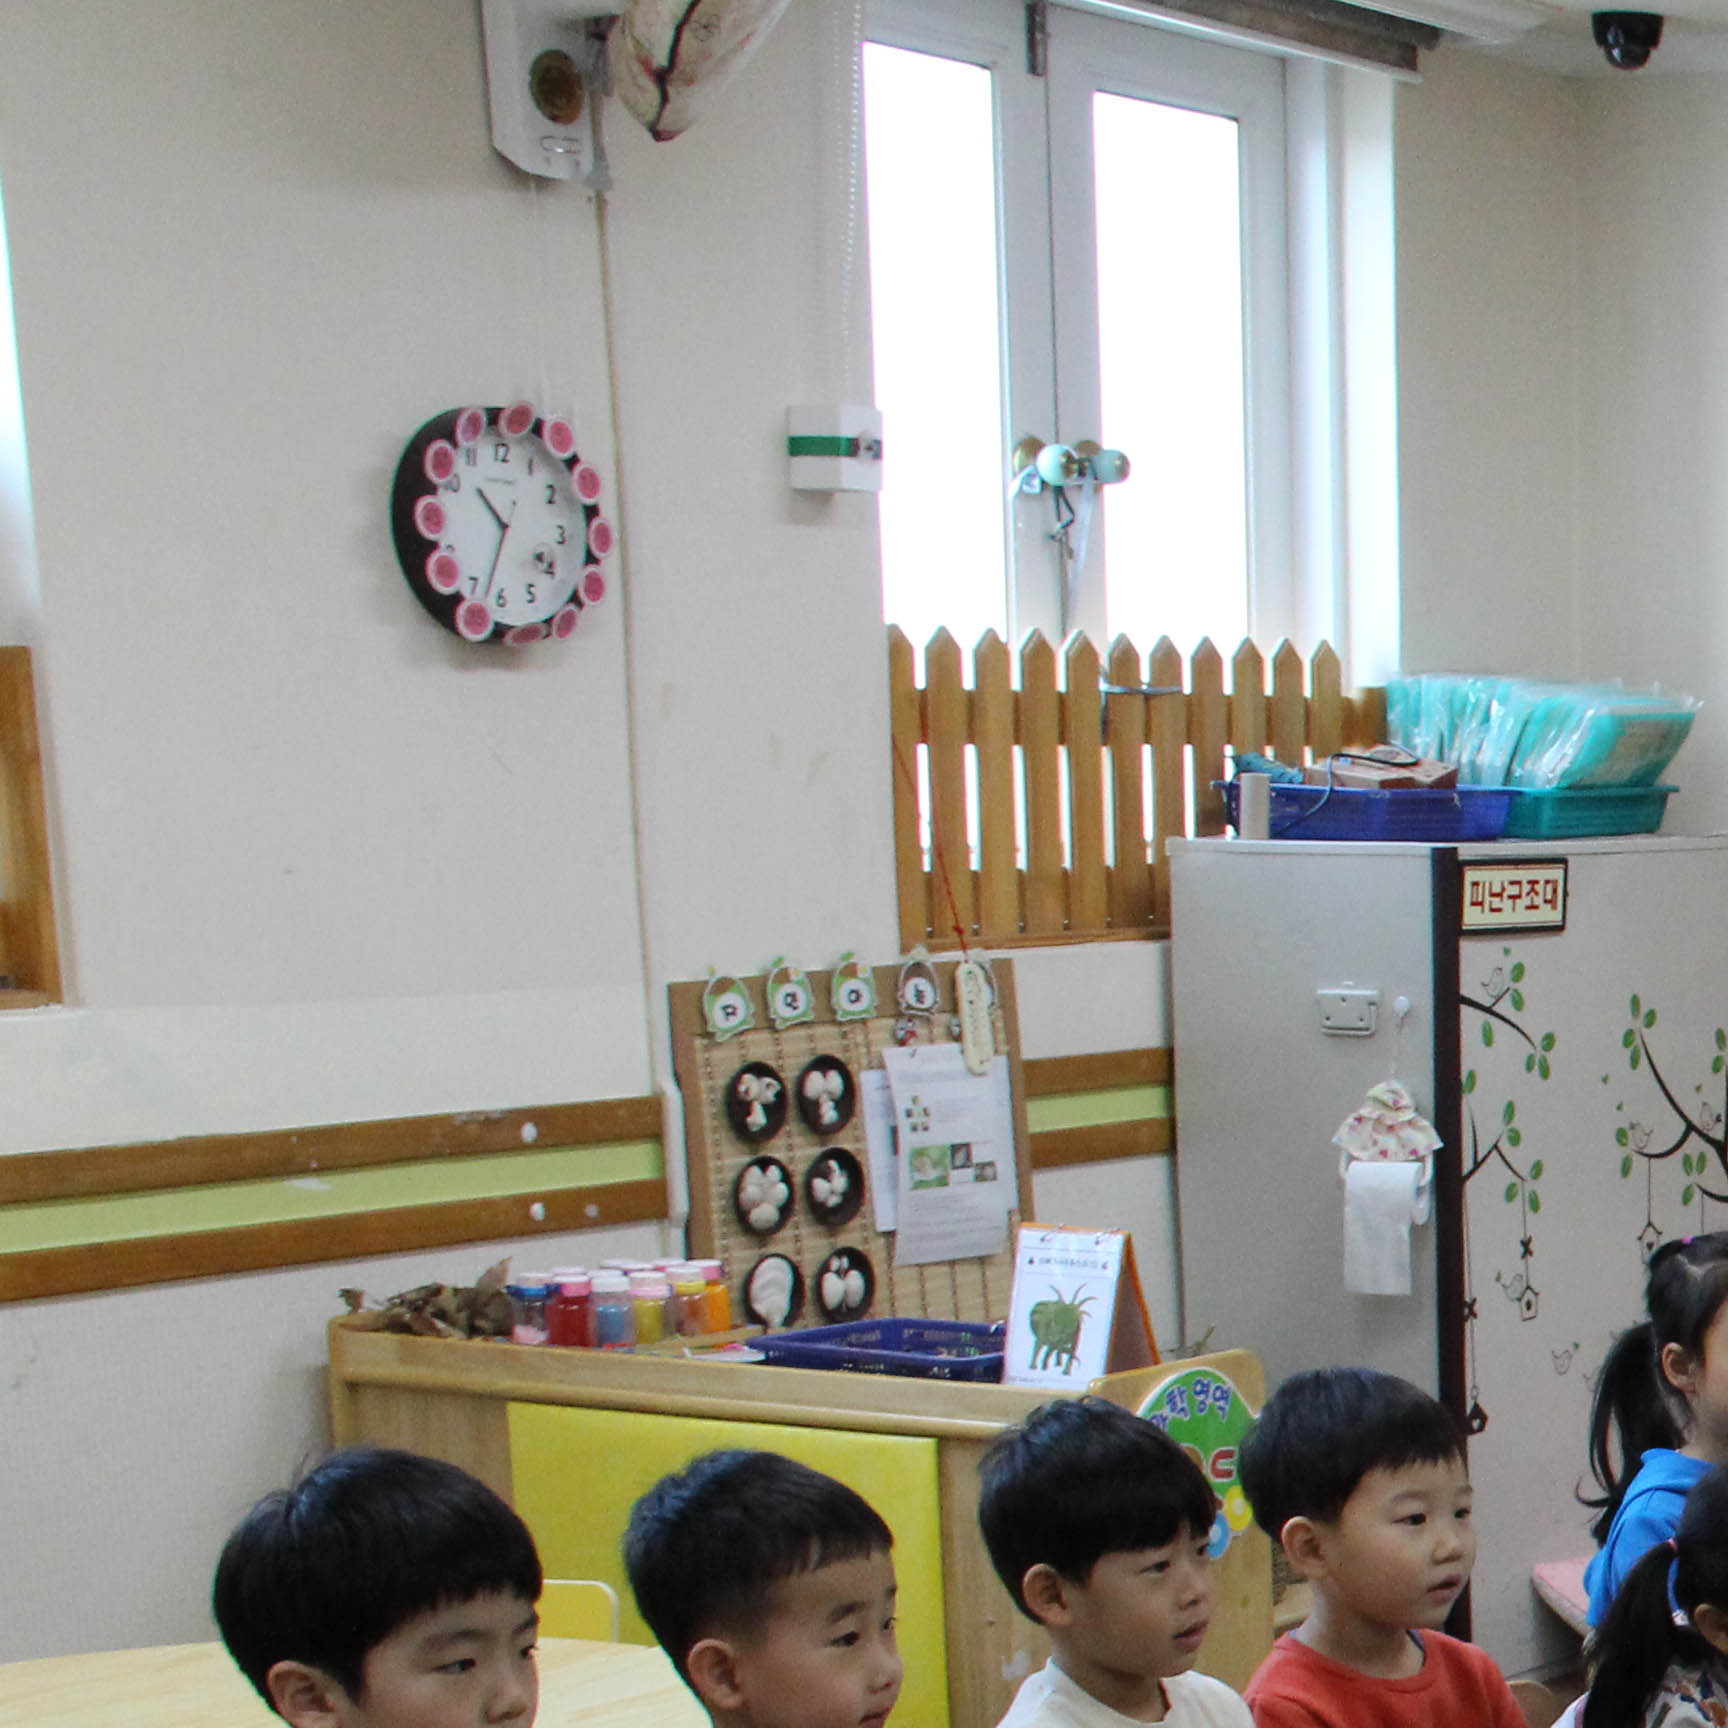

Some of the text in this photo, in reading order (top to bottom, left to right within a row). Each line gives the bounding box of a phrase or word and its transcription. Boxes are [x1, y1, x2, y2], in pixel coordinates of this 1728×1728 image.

[493, 442, 510, 463] 12
[545, 483, 556, 504] 2
[556, 525, 566, 545] 3
[468, 576, 478, 595] 7
[526, 583, 536, 604] 5
[496, 588, 507, 608] 6
[1468, 878, 1559, 915] 피난구조대
